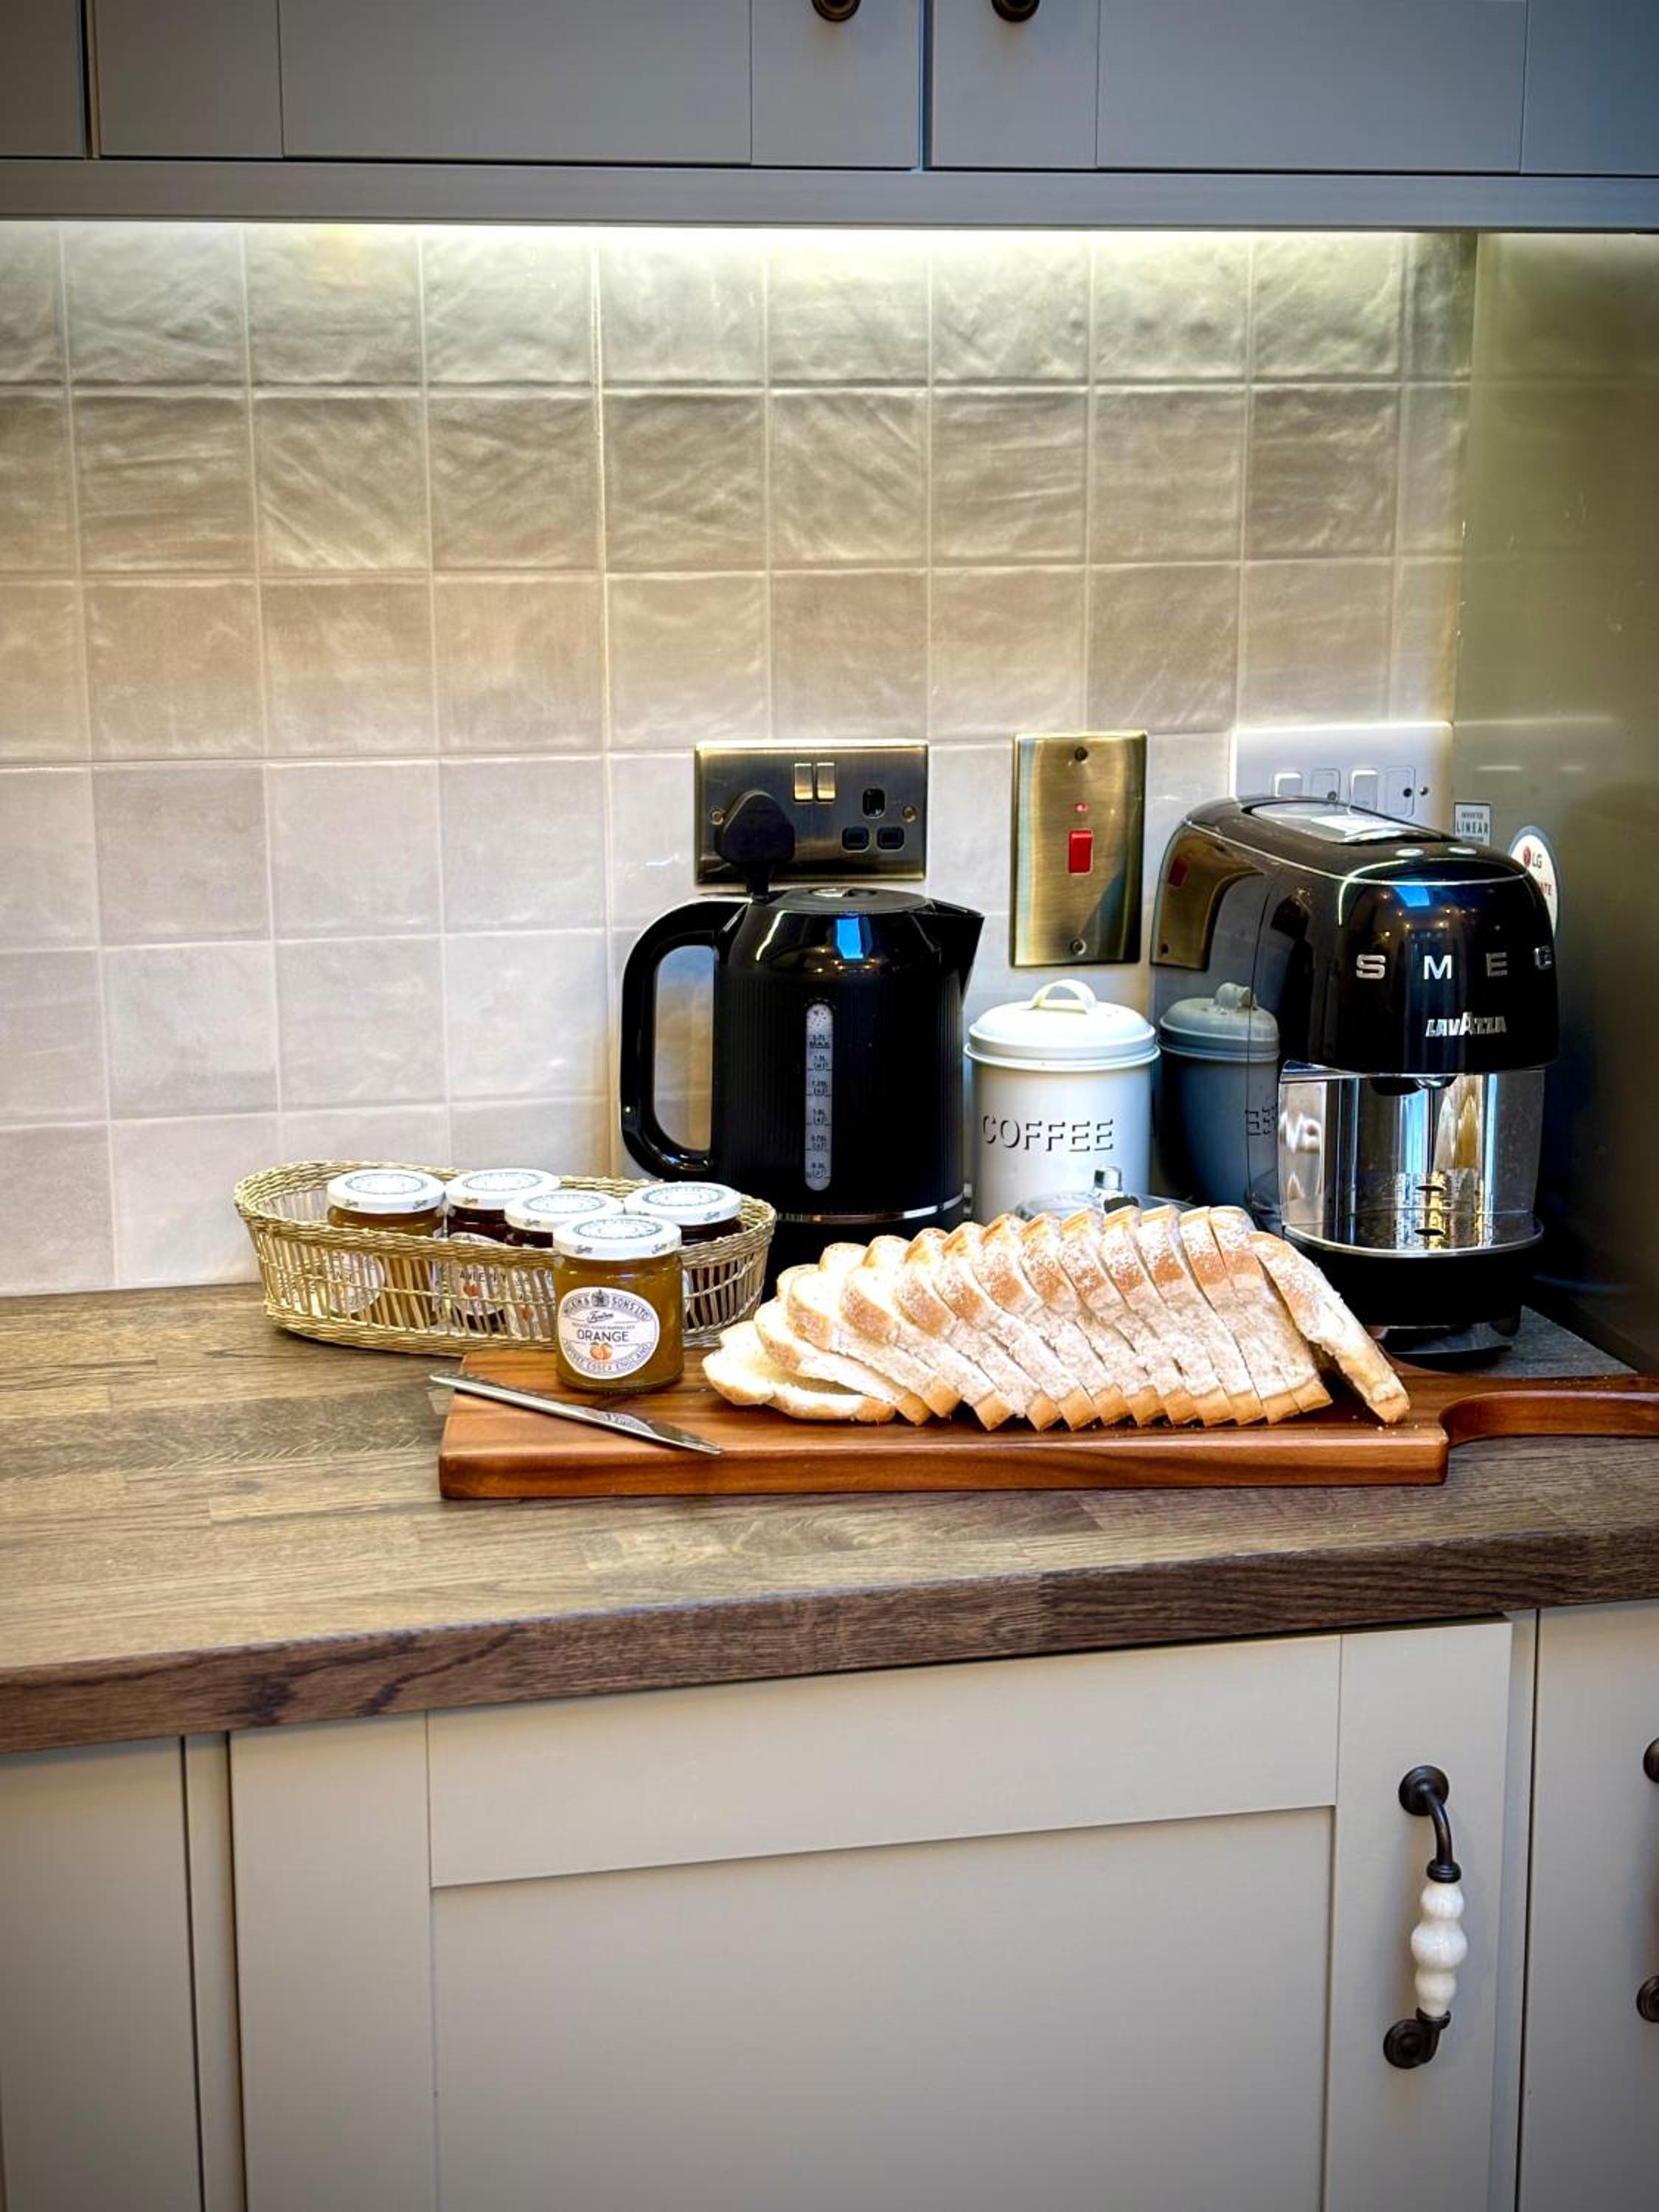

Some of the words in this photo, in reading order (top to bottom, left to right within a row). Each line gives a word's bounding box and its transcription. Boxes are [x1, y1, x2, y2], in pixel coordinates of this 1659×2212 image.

[1456, 820, 1489, 835] LINEAR
[1532, 852, 1543, 869] LG
[1355, 945, 1552, 980] SMEG
[1425, 1012, 1508, 1037] LAVAZZA
[983, 1114, 1113, 1152] COFFEE
[612, 1297, 635, 1310] SONS
[577, 1329, 630, 1342] ORANGE
